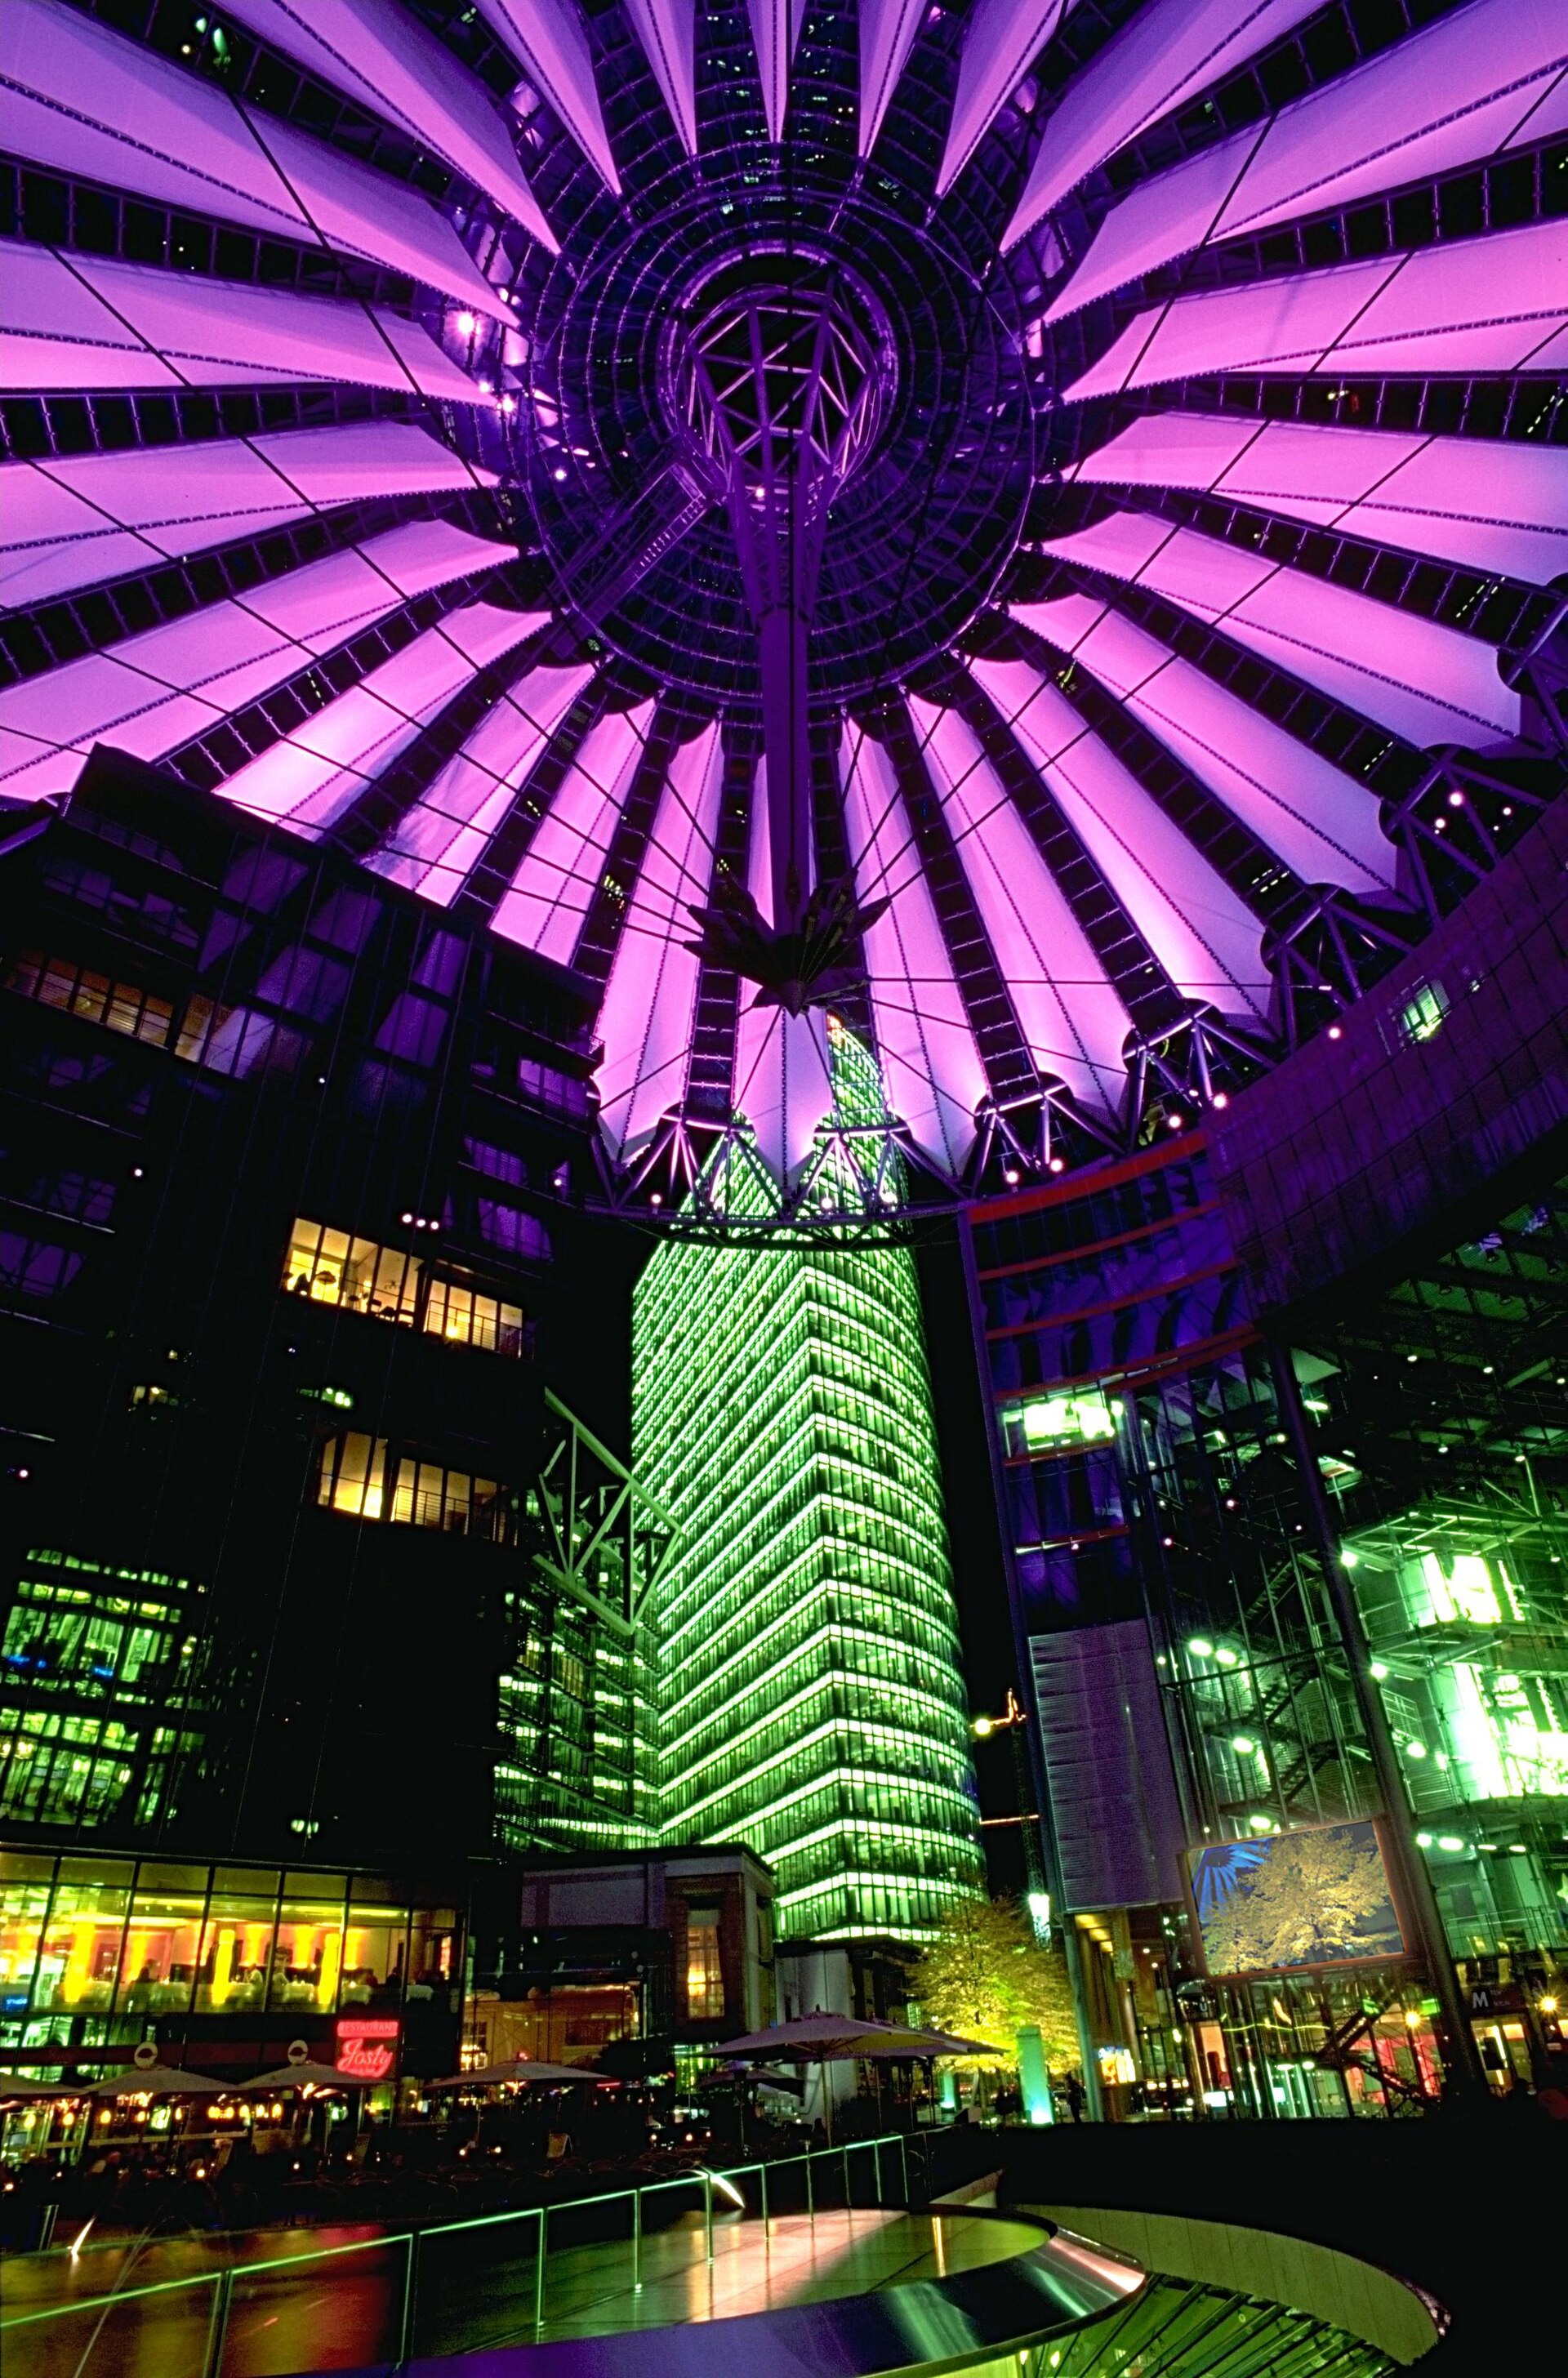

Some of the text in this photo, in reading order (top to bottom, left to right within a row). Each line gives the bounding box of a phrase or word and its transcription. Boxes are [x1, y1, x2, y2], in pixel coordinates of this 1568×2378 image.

[1472, 1991, 1489, 2008] M
[338, 2021, 398, 2034] RESTAURANT
[337, 2038, 393, 2077] Josty
